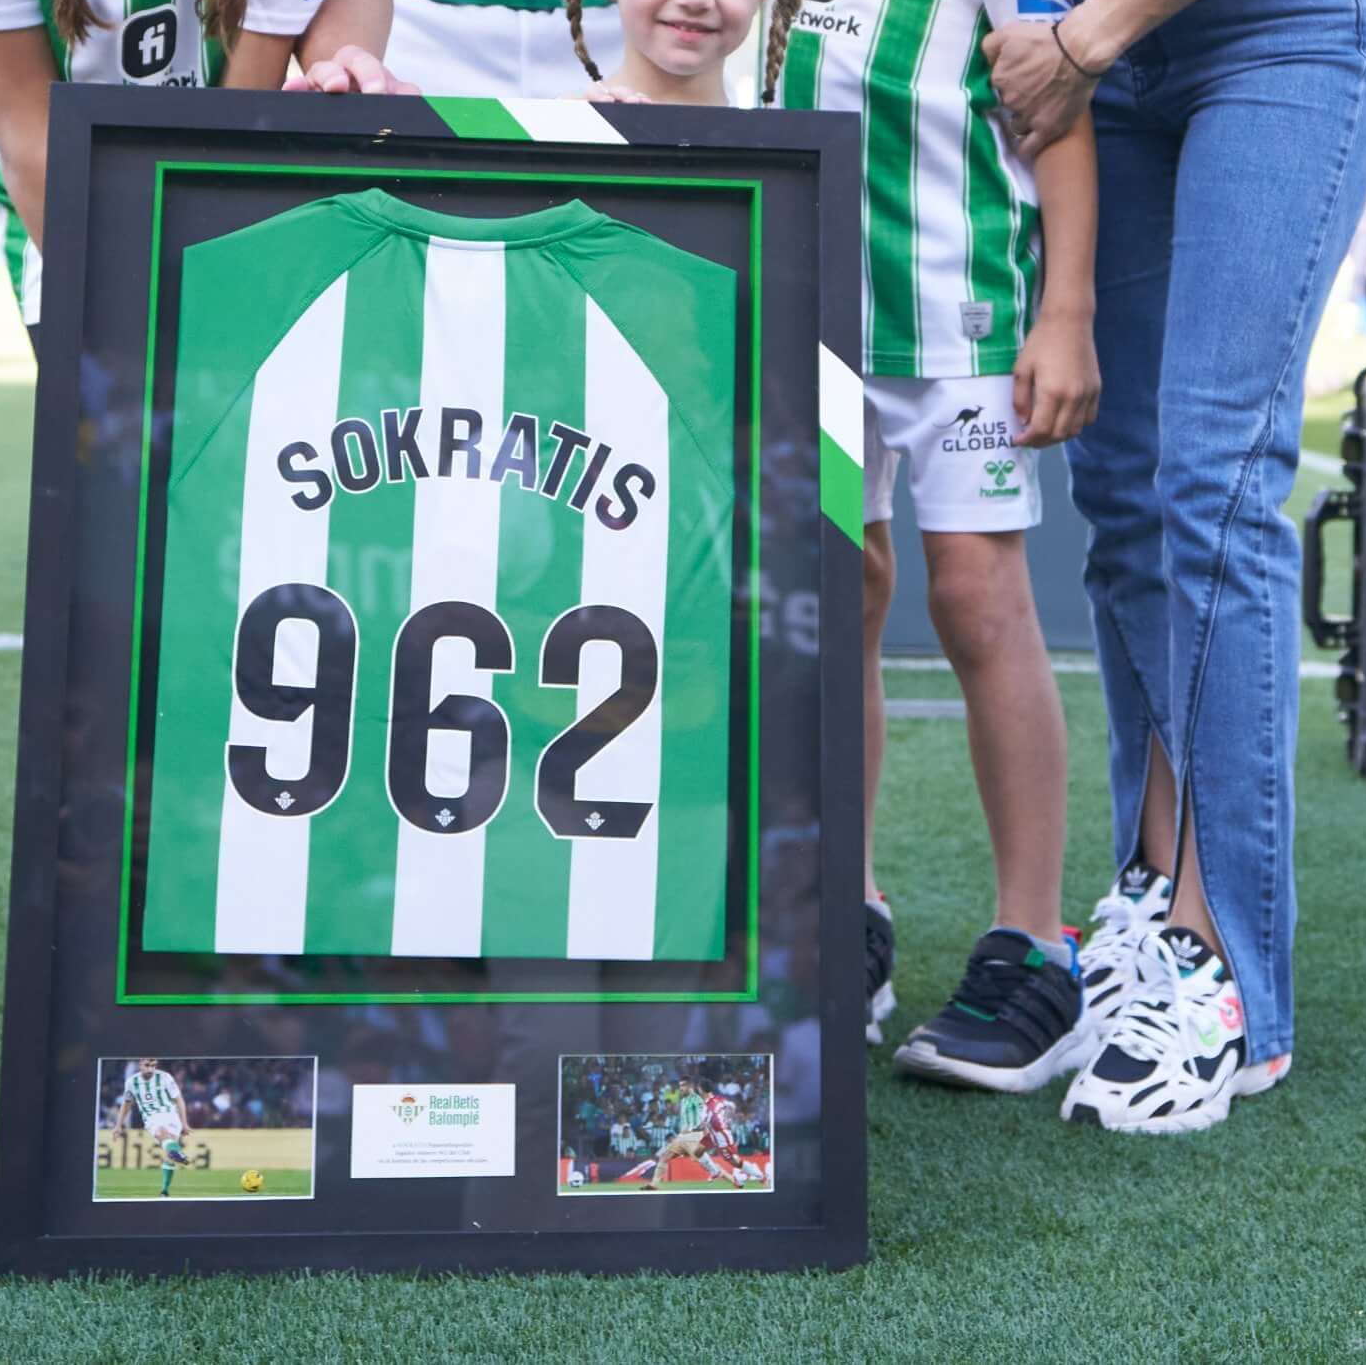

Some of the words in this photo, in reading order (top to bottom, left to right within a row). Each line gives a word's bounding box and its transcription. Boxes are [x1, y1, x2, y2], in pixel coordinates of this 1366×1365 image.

[138, 22, 165, 65] fi
[942, 435, 1017, 452] GLOBAL
[969, 421, 1007, 436] AUS
[276, 406, 657, 531] SOKRATIS
[226, 582, 658, 840] 962
